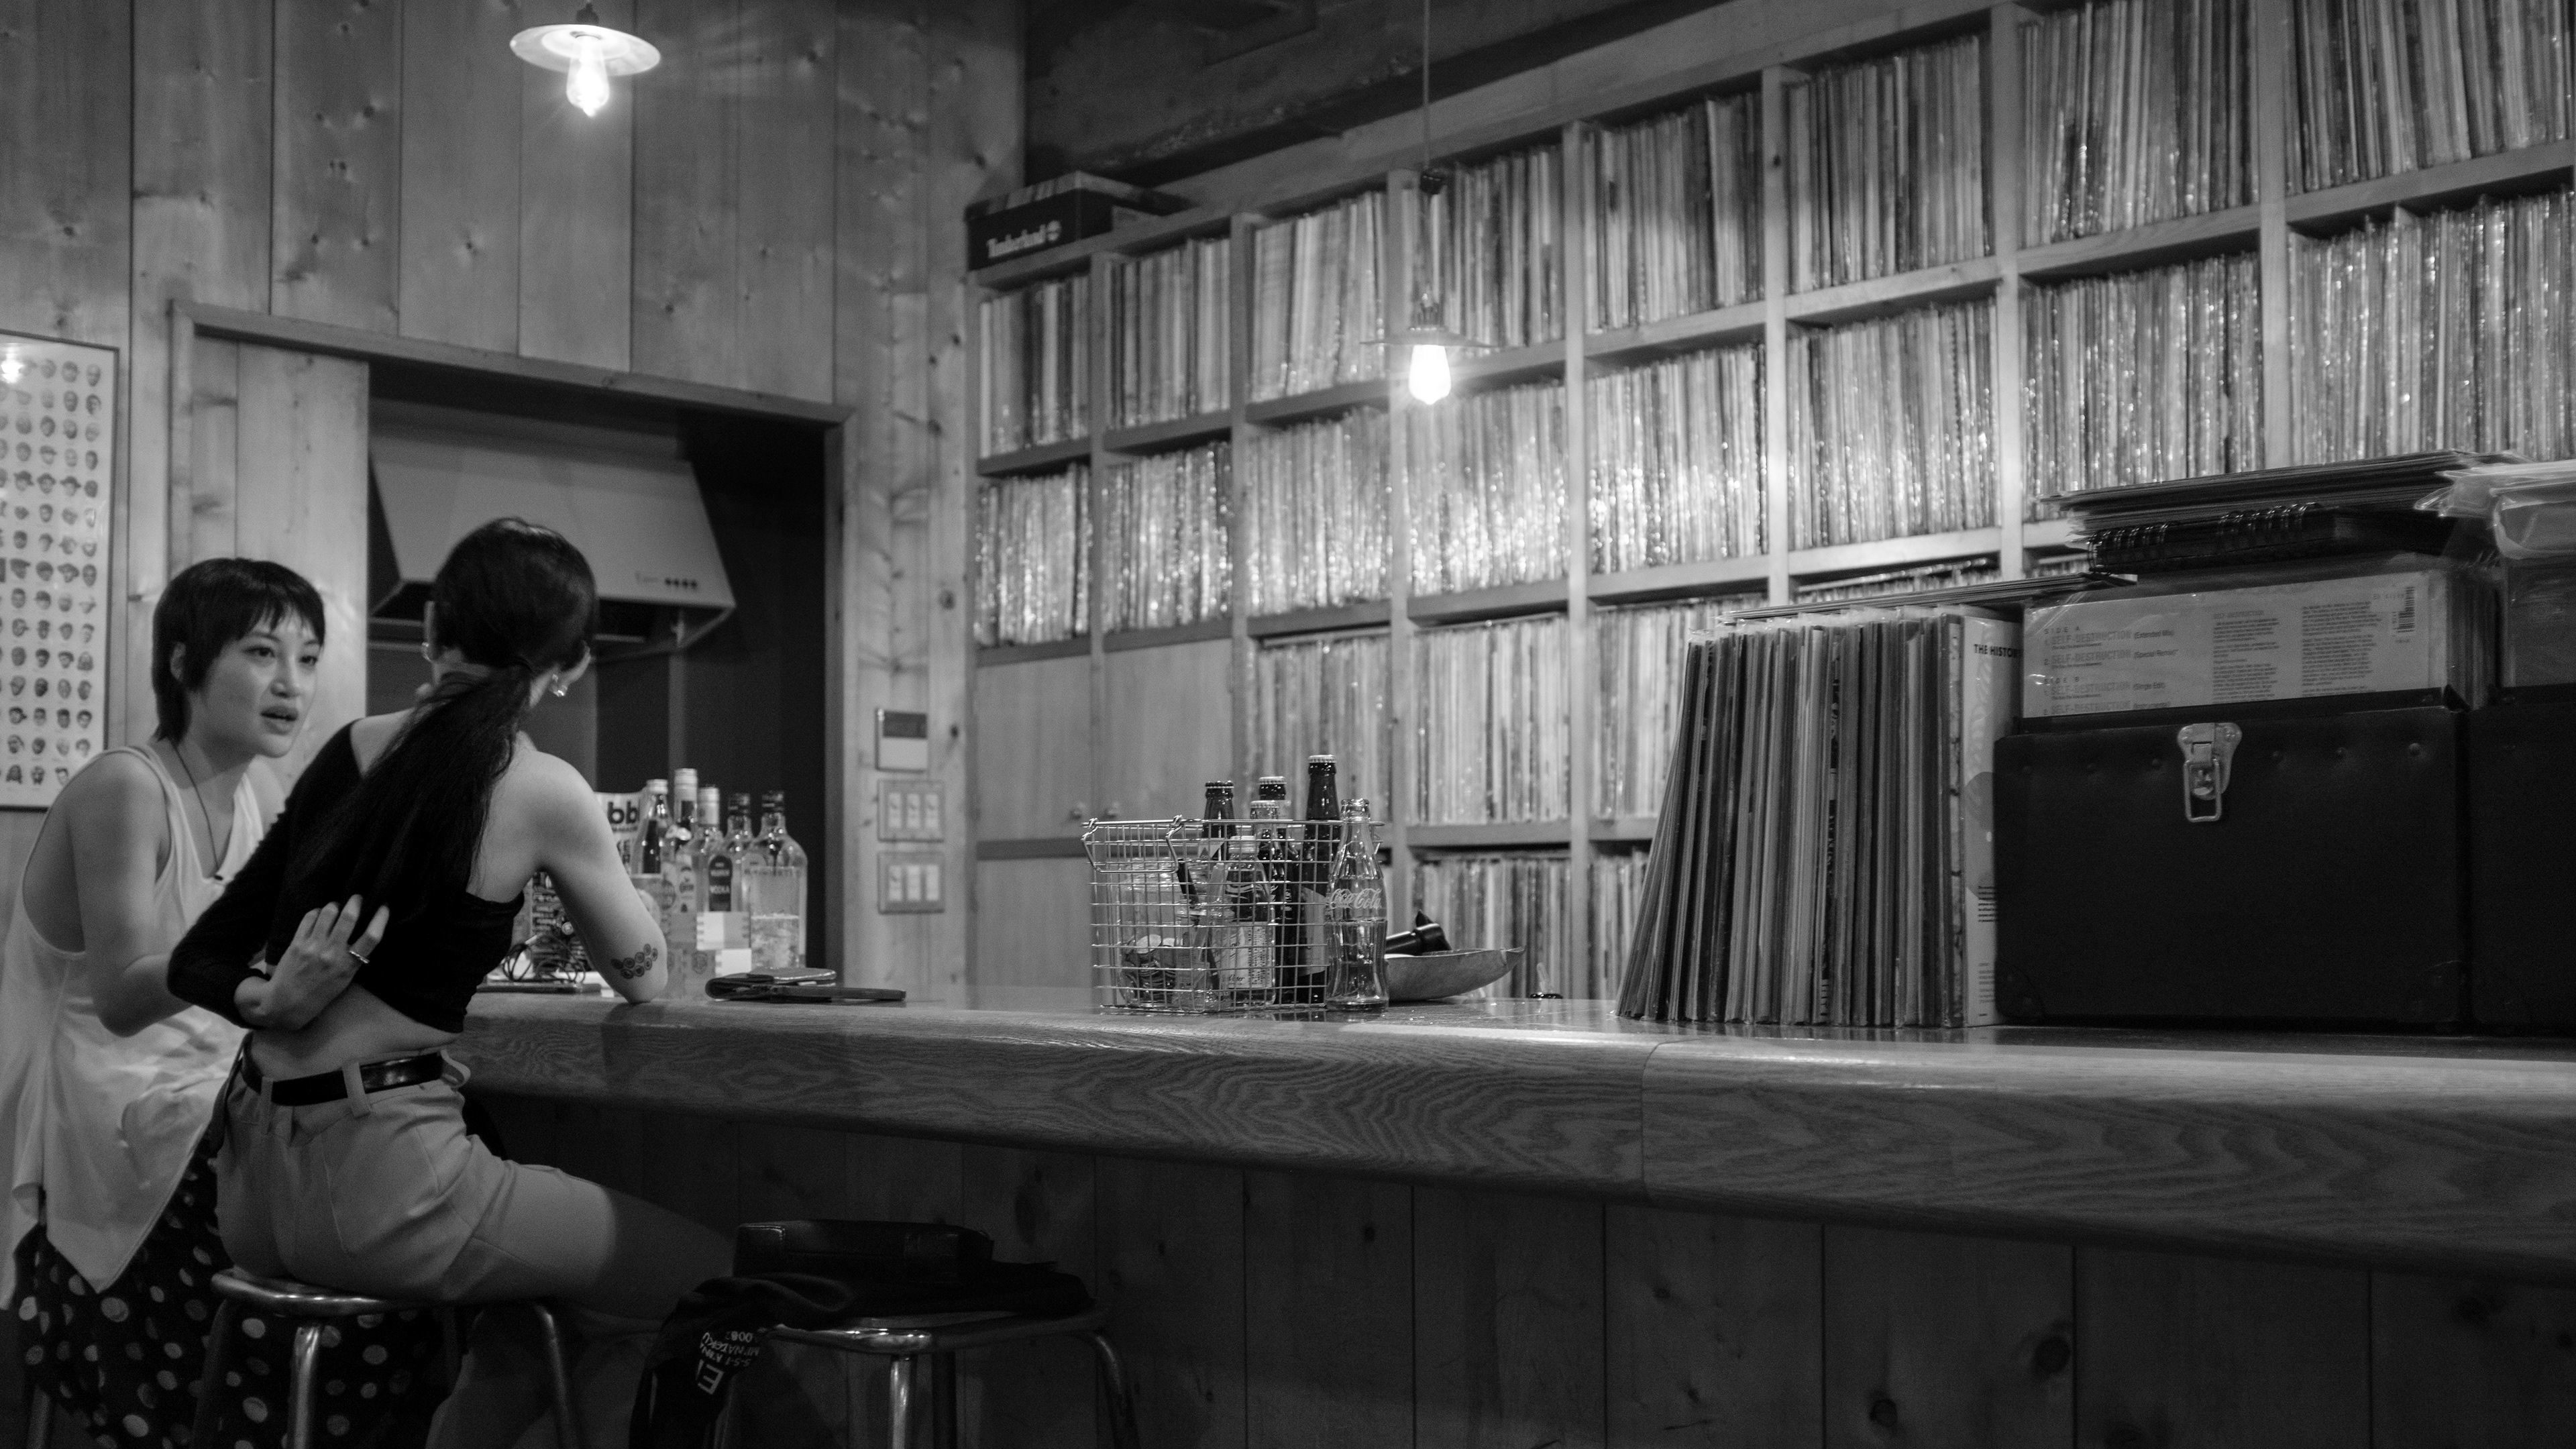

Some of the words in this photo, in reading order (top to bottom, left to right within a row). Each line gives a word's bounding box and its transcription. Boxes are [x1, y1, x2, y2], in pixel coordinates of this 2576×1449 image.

[2051, 629, 2131, 645] SELF-DESTRUCTION
[1974, 643, 1988, 655] THE
[2051, 649, 2131, 665] SELF-DESTRUCTION
